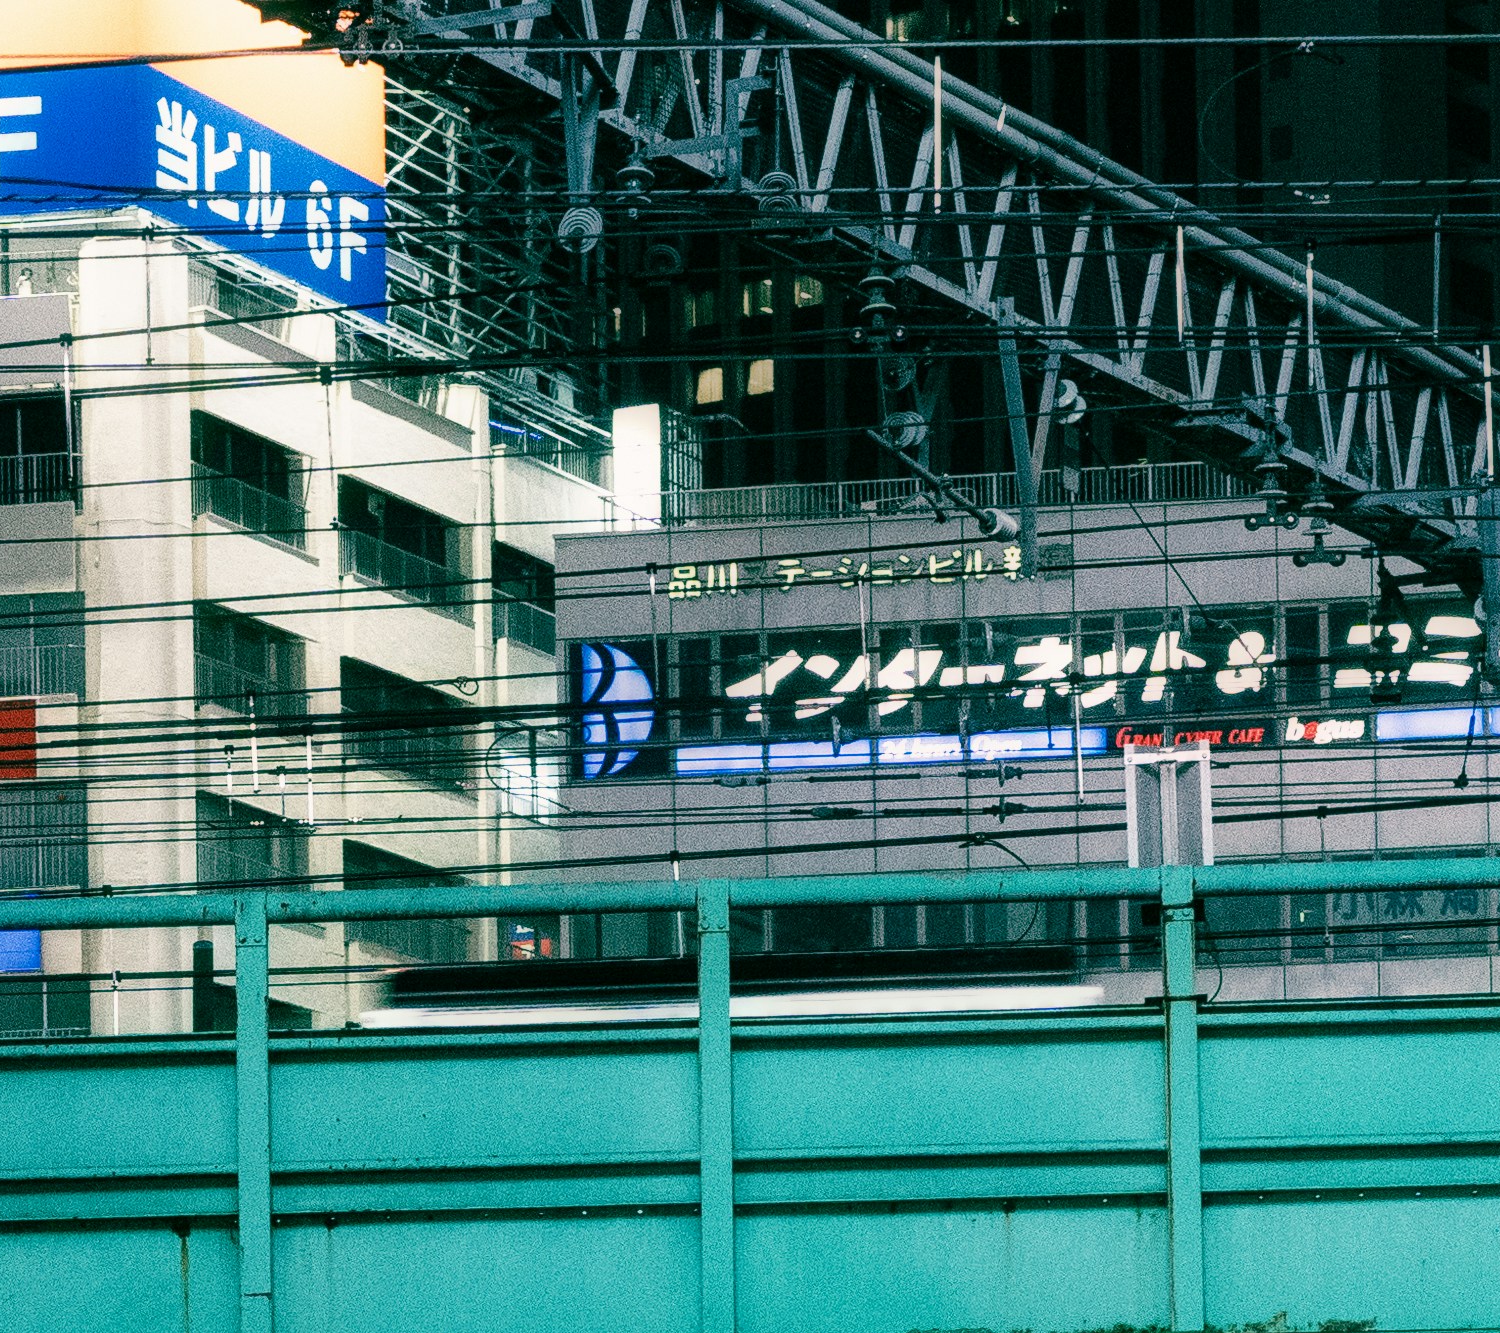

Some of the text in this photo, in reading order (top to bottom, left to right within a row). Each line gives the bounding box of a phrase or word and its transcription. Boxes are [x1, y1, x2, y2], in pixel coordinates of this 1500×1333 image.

[155, 96, 370, 282] 当ビル 6F
[725, 631, 1206, 723] インターネット
[1215, 632, 1277, 695] &
[1228, 728, 1265, 744] CAFE
